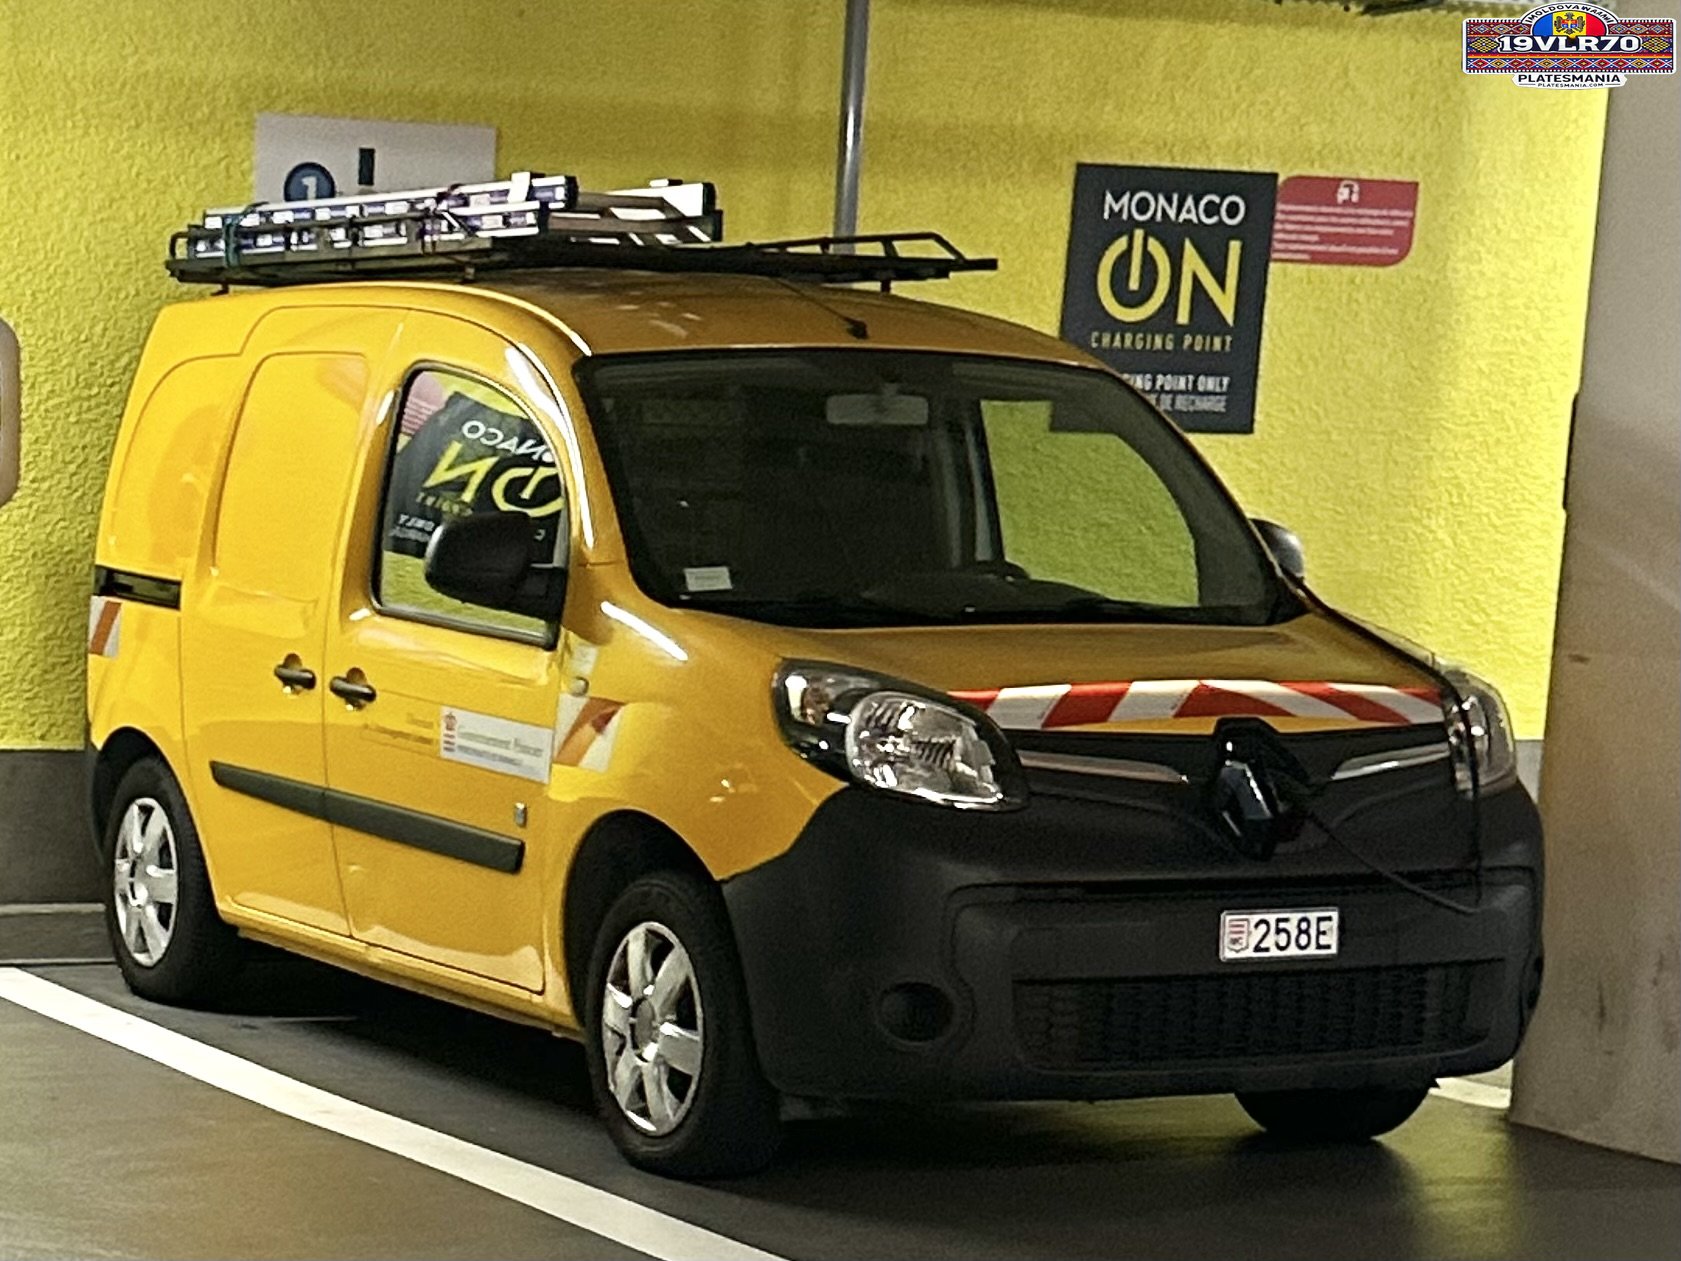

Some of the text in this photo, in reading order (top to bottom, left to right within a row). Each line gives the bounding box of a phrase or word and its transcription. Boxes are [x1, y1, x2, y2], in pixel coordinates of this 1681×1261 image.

[1103, 190, 1245, 225] MONACO
[1097, 228, 1242, 327] ON
[1091, 331, 1232, 351] CHARGING POINT
[1155, 373, 1195, 392] POINT
[1197, 374, 1231, 393] ONLY
[1253, 915, 1333, 952] 258E
